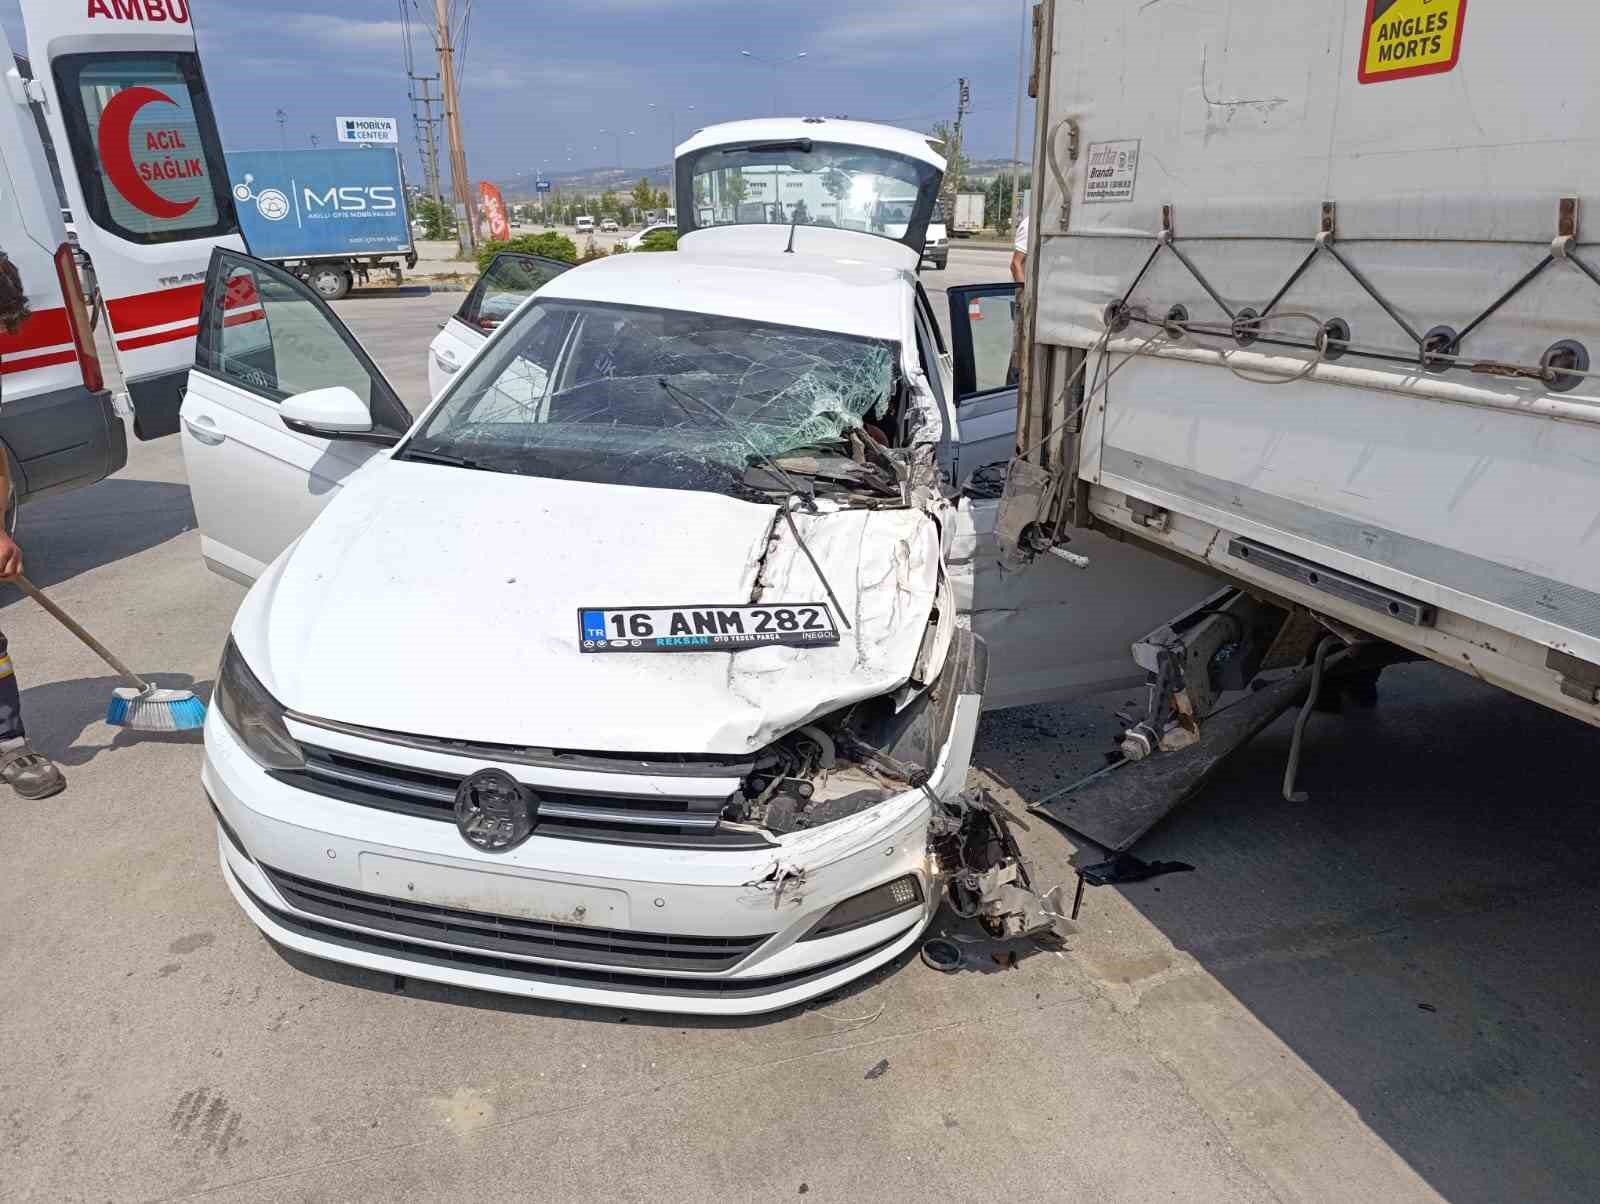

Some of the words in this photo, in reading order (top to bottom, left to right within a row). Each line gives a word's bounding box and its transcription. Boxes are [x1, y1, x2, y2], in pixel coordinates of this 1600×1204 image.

[1377, 11, 1449, 42] ANGLES
[1378, 35, 1442, 63] MORTS
[145, 130, 185, 150] ACİL
[357, 130, 389, 139] CENTER
[139, 156, 204, 181] SAĞLIK
[303, 186, 397, 212] MS'S
[587, 628, 604, 637] TR
[610, 613, 654, 638] 16
[669, 611, 745, 636] ANM
[750, 608, 825, 633] 282
[655, 636, 709, 646] REKSAN
